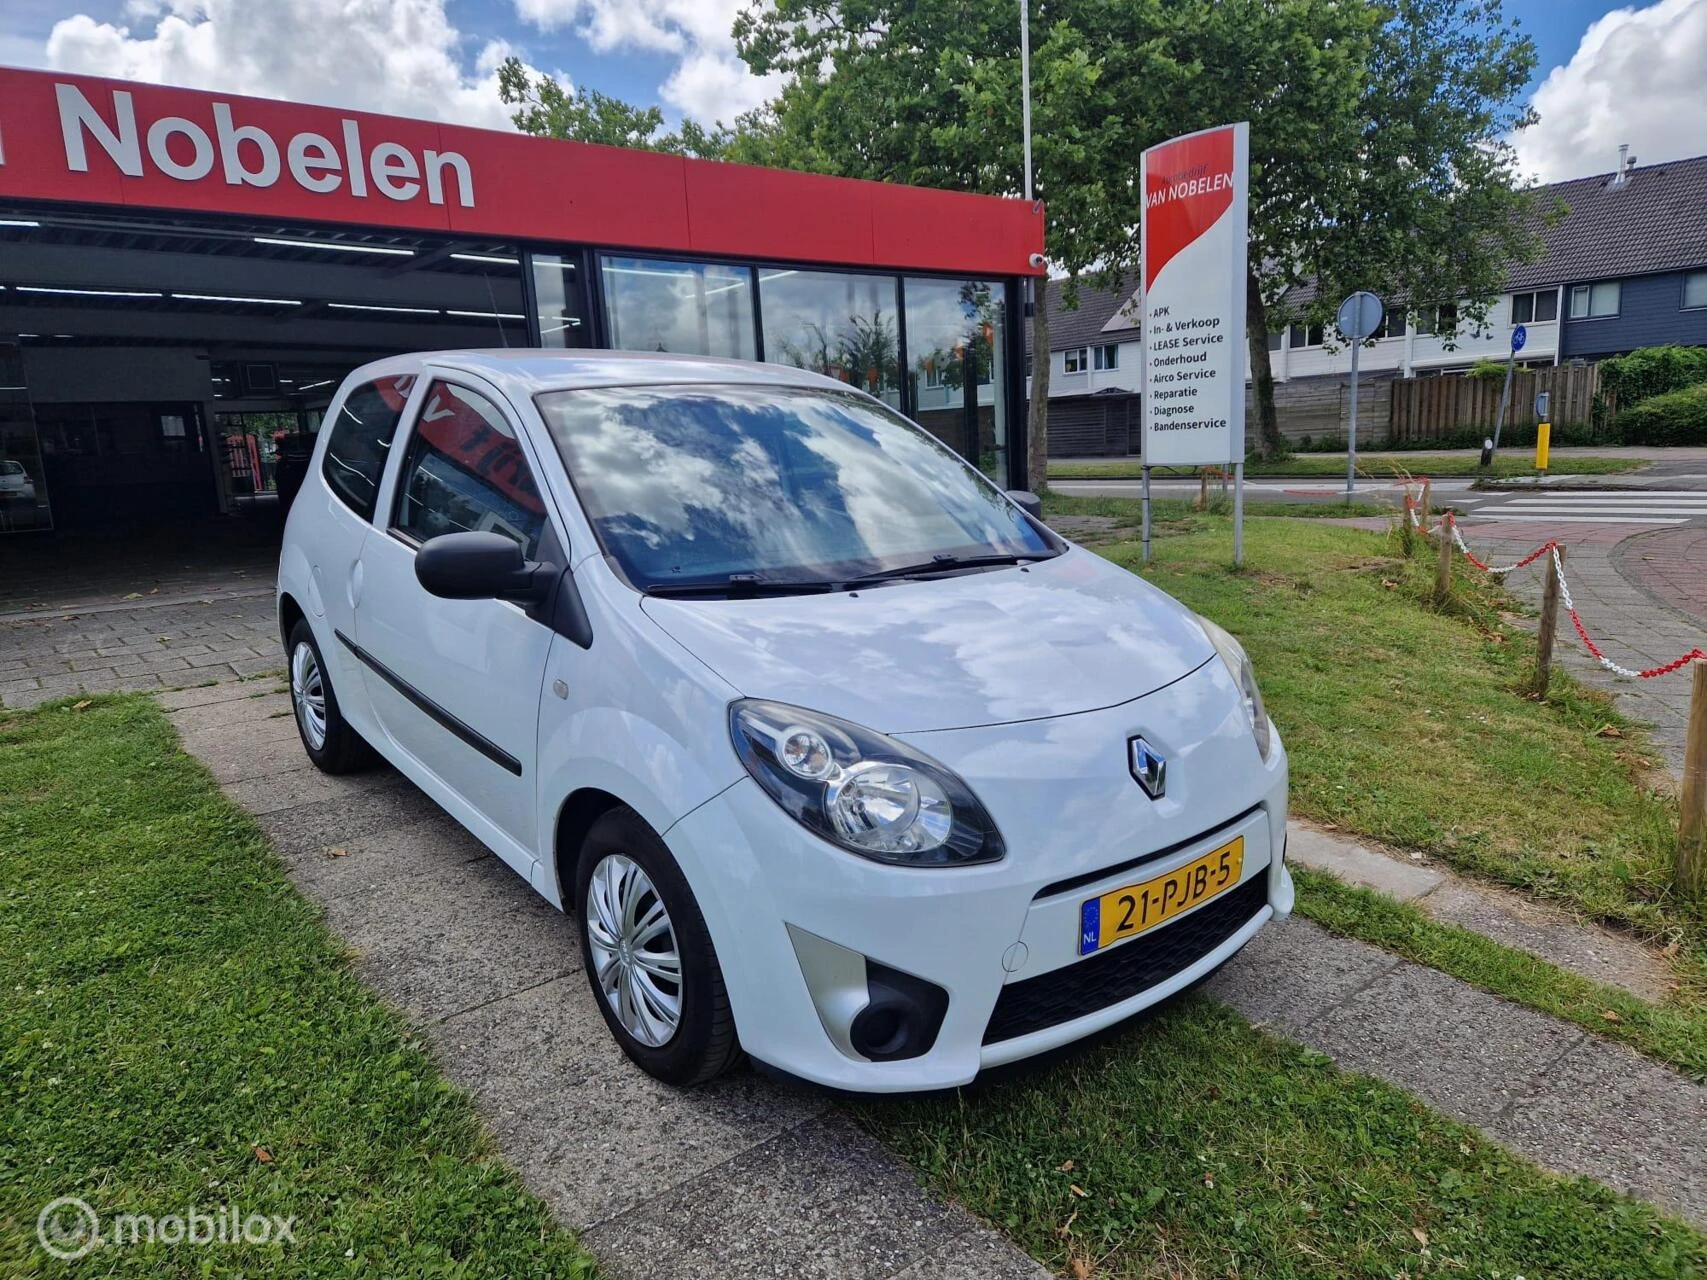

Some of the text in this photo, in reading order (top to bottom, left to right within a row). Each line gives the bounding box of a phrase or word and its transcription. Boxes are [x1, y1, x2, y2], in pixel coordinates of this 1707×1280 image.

[55, 83, 475, 207] Nobelen
[1146, 172, 1233, 208] VAN NOBELEN
[1153, 306, 1170, 318] APK
[1166, 323, 1173, 333] &
[1175, 317, 1220, 330] Verkoop
[1153, 333, 1224, 351] LEASE Service
[1153, 352, 1207, 367] Onderhoud
[1153, 369, 1216, 383] Airco Service
[1154, 386, 1198, 400] Reparatie
[1154, 404, 1194, 417] Diagnose
[1154, 418, 1227, 432] Bandenservice
[1116, 851, 1231, 933] 21-PJB-5
[1083, 931, 1097, 945] NL
